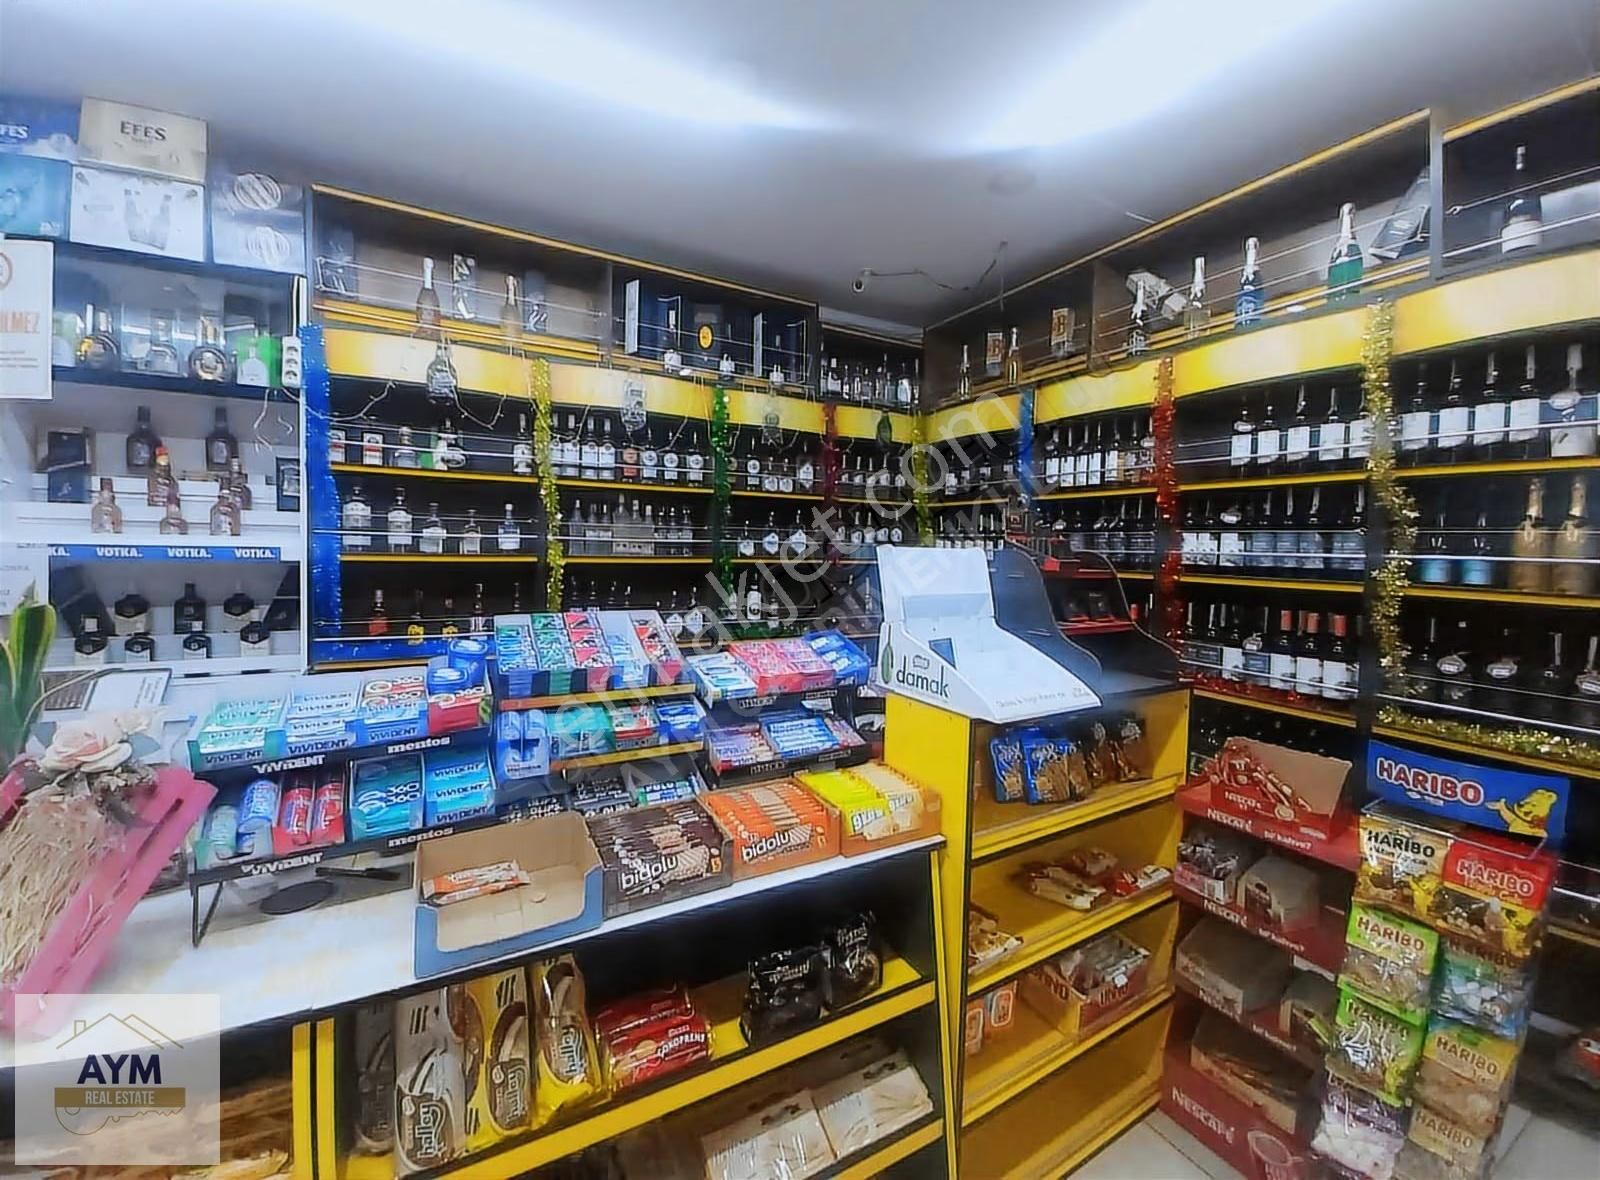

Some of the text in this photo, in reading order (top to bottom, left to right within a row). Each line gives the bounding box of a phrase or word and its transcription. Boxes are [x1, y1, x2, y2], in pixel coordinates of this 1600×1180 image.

[0, 123, 29, 140] FES
[119, 119, 167, 142] EFES
[896, 656, 949, 699] damak
[387, 736, 451, 754] mentos
[1377, 757, 1484, 806] HARIBO
[388, 827, 454, 847] mentos
[741, 831, 791, 862] bidolu
[1367, 830, 1435, 859] HARIBO
[621, 854, 678, 890] bidolu
[1457, 859, 1535, 898] HARIBO
[1357, 916, 1425, 952] HARIBO
[559, 1026, 584, 1075] halley
[1436, 1036, 1498, 1076] HARIBO
[416, 1102, 446, 1159] halley
[1414, 1107, 1474, 1148] HARIBO
